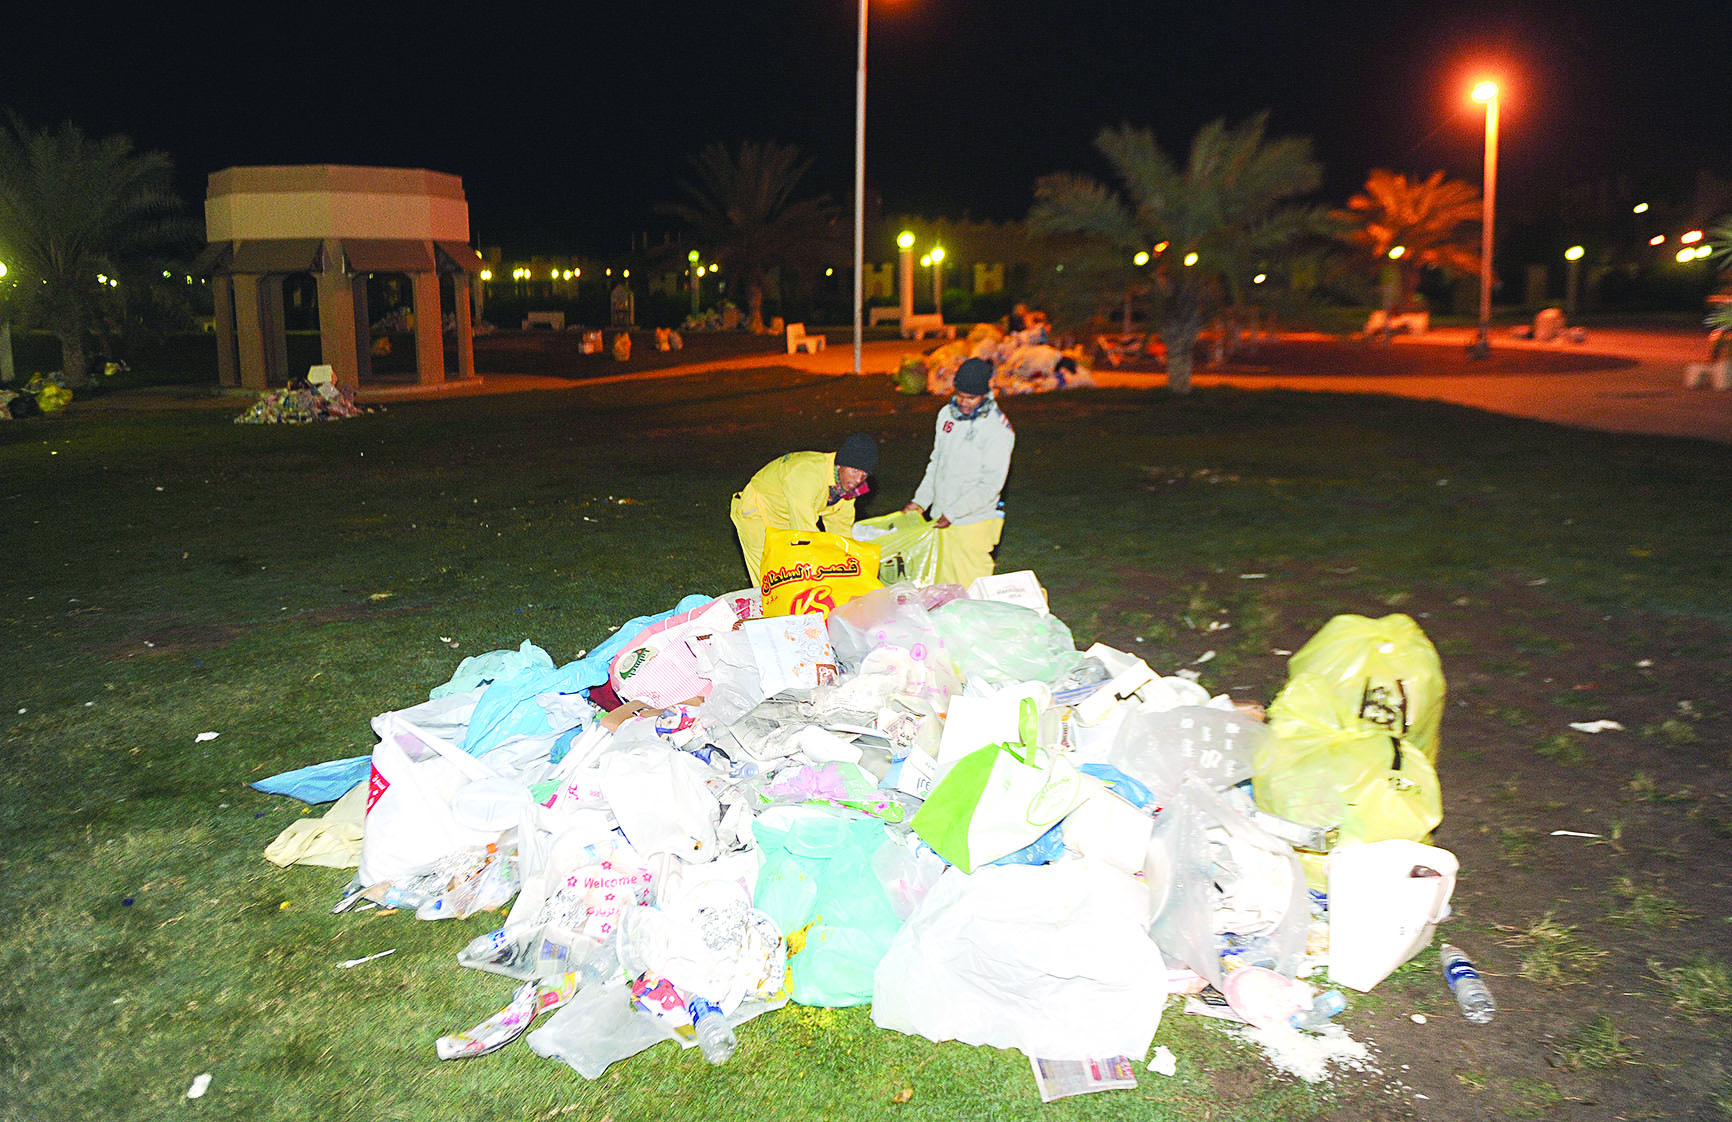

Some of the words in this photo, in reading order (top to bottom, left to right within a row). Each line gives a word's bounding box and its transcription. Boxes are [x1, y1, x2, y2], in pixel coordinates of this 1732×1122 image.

[762, 564, 811, 594] السلطان
[813, 558, 860, 580] قصر
[584, 875, 638, 889] Welcome
